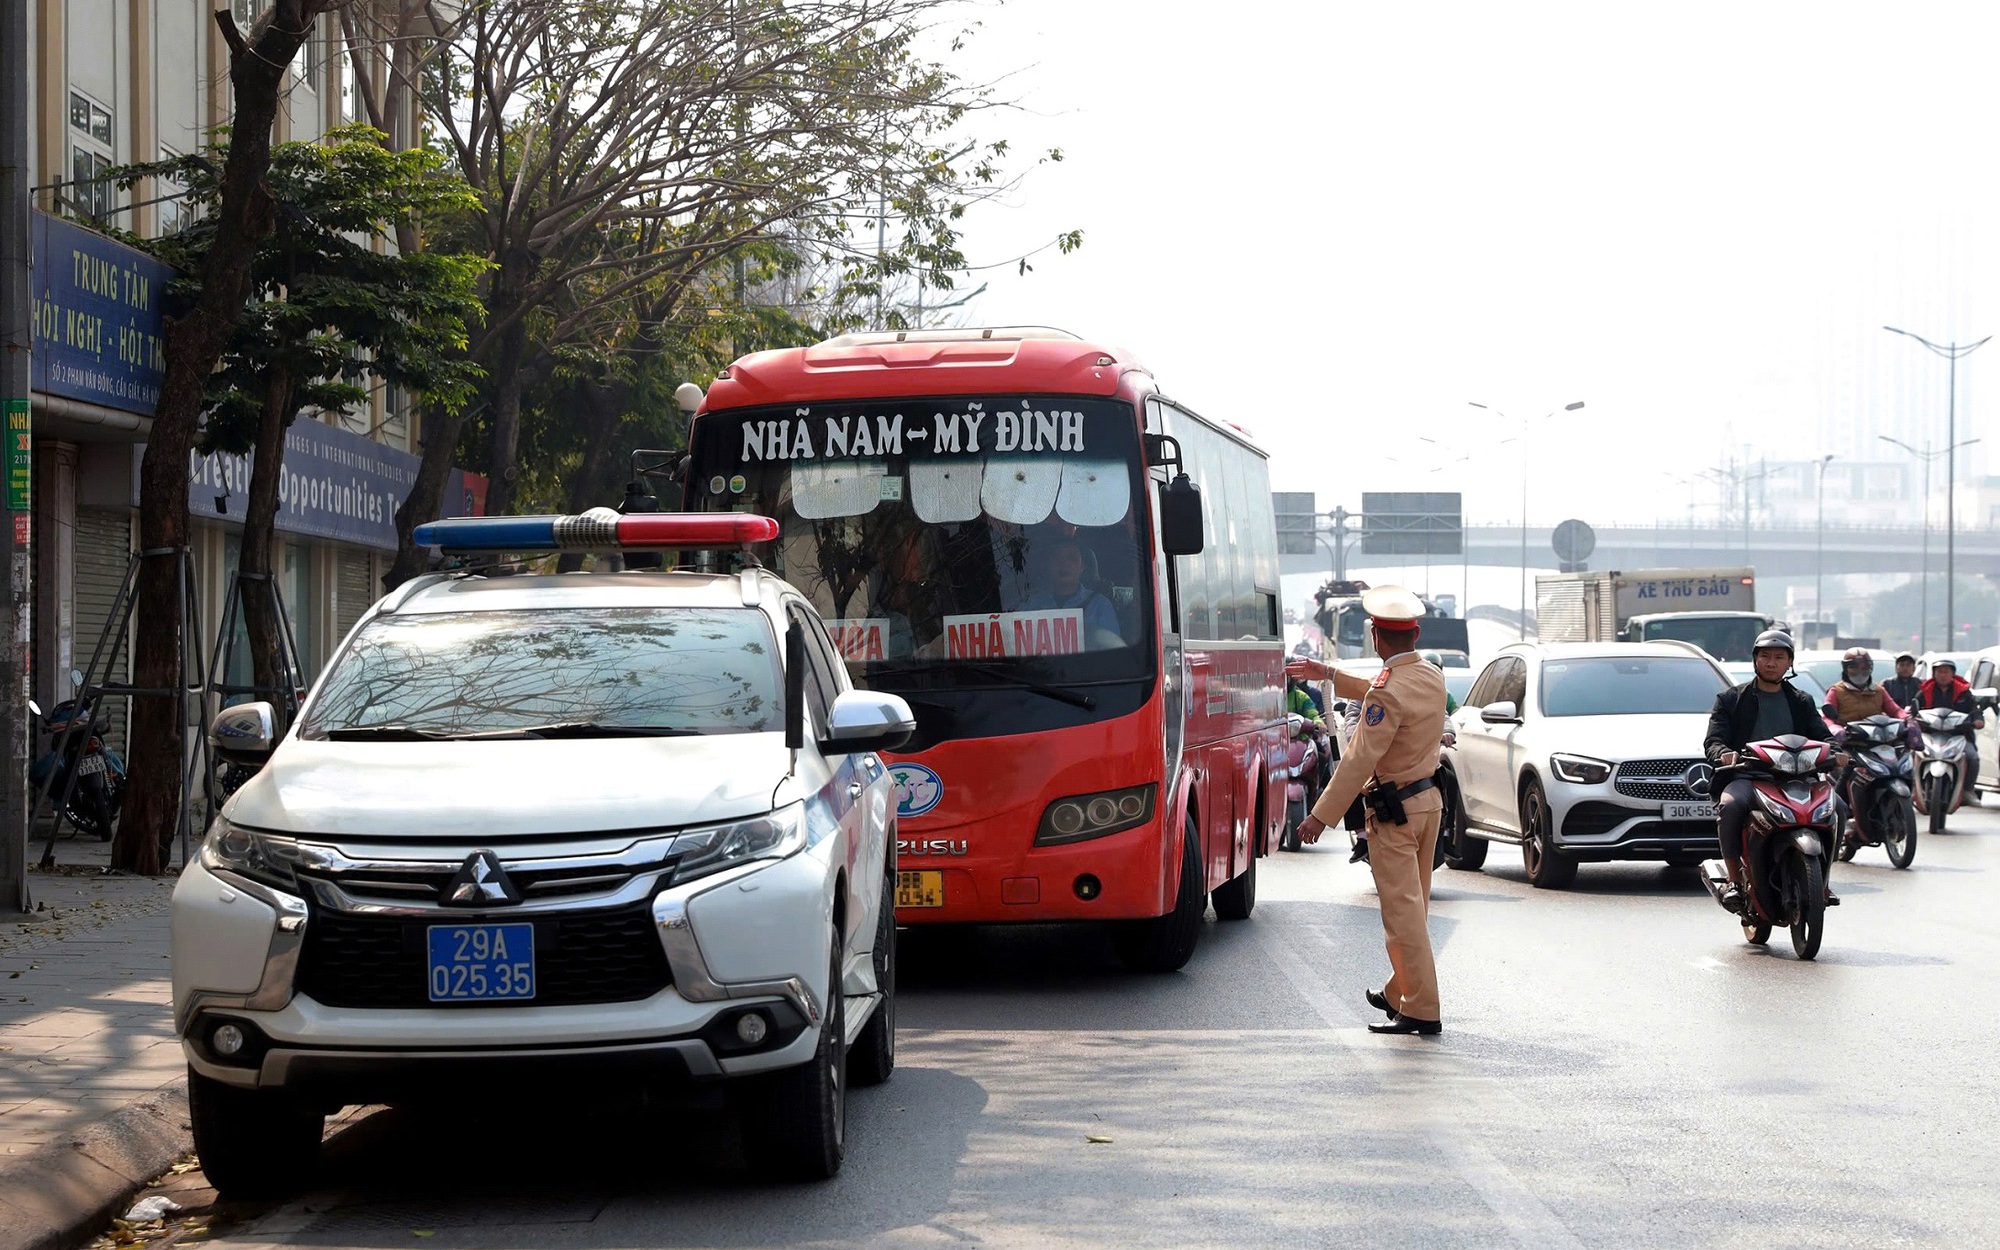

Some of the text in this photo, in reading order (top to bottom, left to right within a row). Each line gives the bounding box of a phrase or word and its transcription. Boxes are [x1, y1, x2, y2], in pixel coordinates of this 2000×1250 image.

[73, 250, 118, 300] TRUNG
[124, 262, 148, 311] TÂM
[67, 308, 102, 363] NGHỊ
[120, 317, 143, 373] HỘI
[148, 335, 167, 373] TH
[62, 366, 67, 382] 2
[741, 399, 1085, 462] NHÃ NAM MỸ ĐÌNH
[321, 443, 375, 473] INTERNATIONAL
[189, 443, 250, 495] Creati
[279, 462, 383, 524] Opportunities
[1637, 582, 1657, 599] XE
[947, 614, 1079, 660] NHÃ NAM
[896, 839, 968, 856] ZUSU
[452, 928, 508, 961] 29A
[432, 963, 531, 997] 025.35
